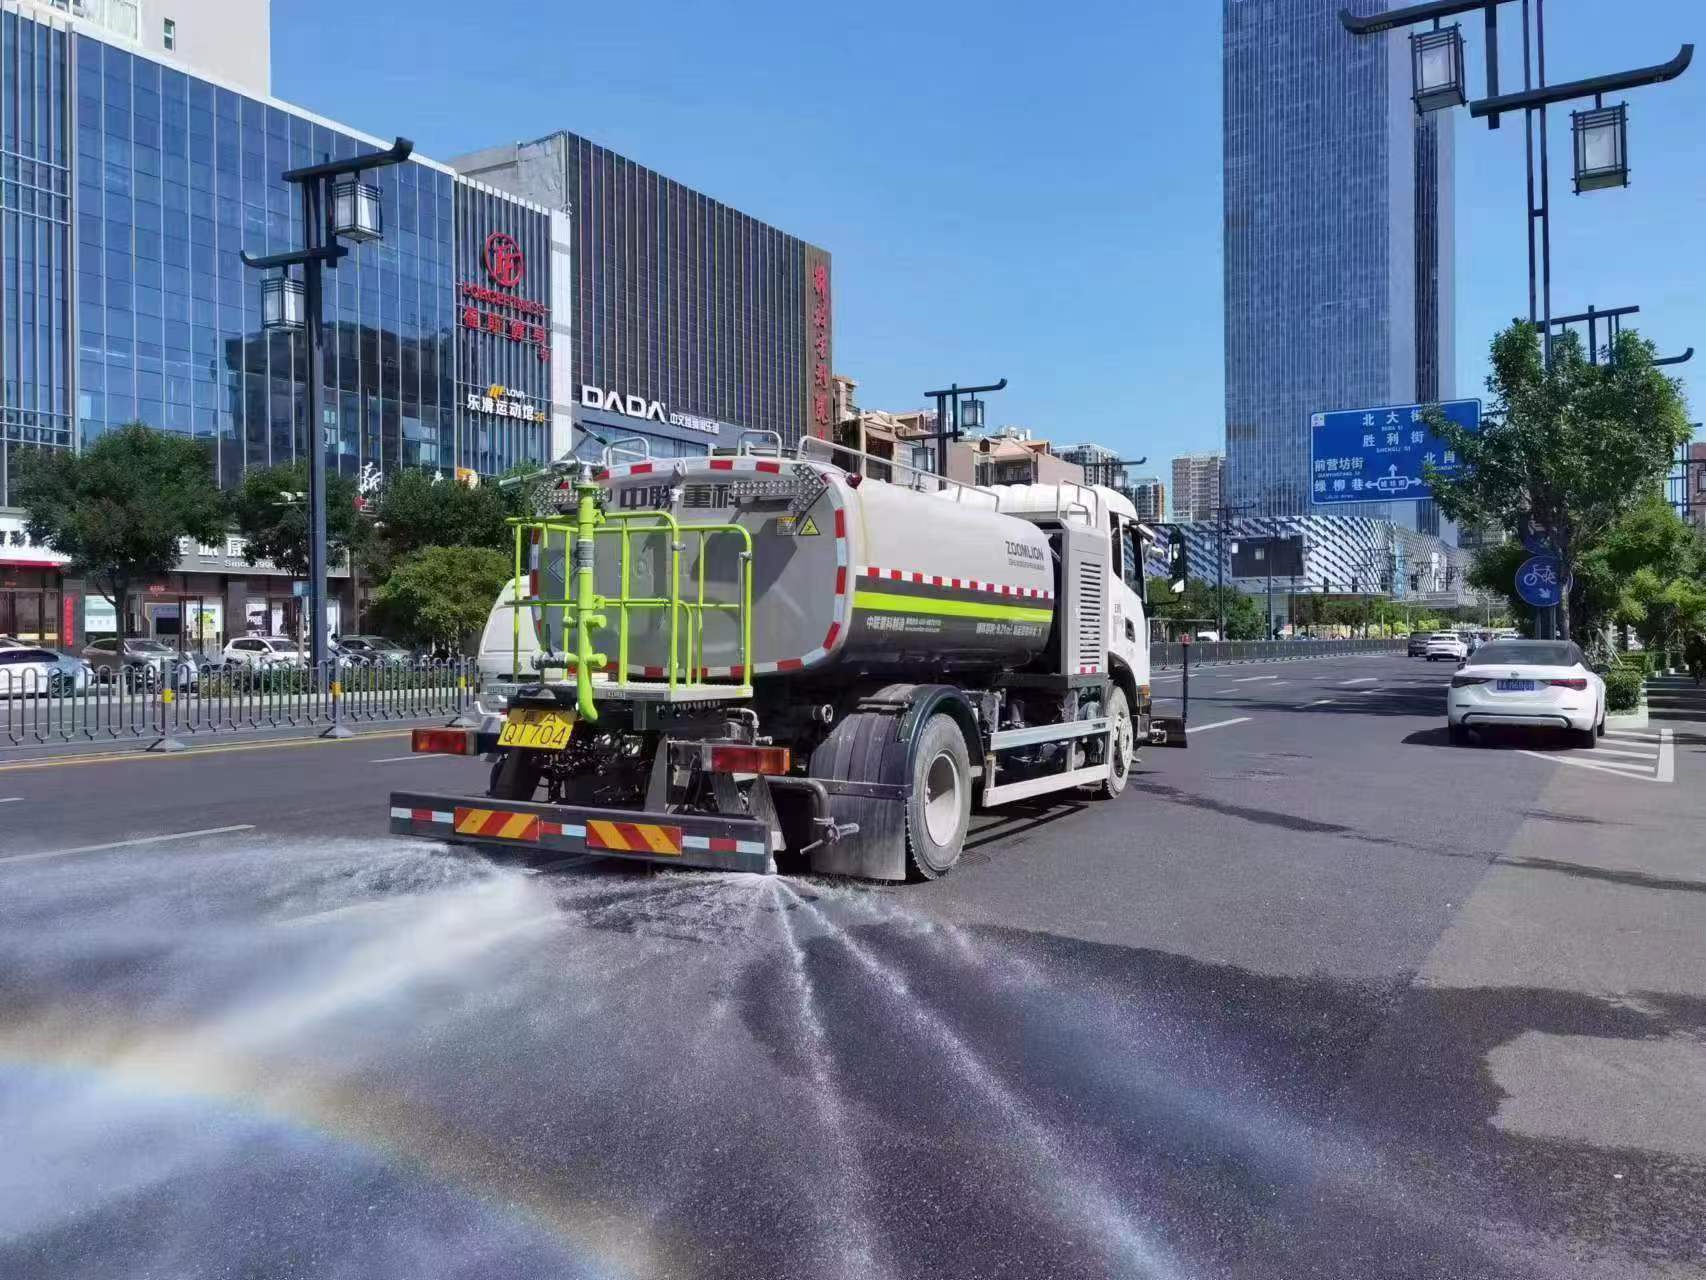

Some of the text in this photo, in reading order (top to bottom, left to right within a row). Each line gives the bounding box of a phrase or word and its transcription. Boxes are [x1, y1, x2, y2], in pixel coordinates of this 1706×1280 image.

[1362, 410, 1423, 427] 北大街
[1362, 430, 1425, 448] 胜利街
[1314, 456, 1363, 473] 前营坊街
[1314, 477, 1364, 493] 绿柳巷
[1005, 540, 1044, 561] ZOOMLION
[503, 722, 567, 745] Q1704
